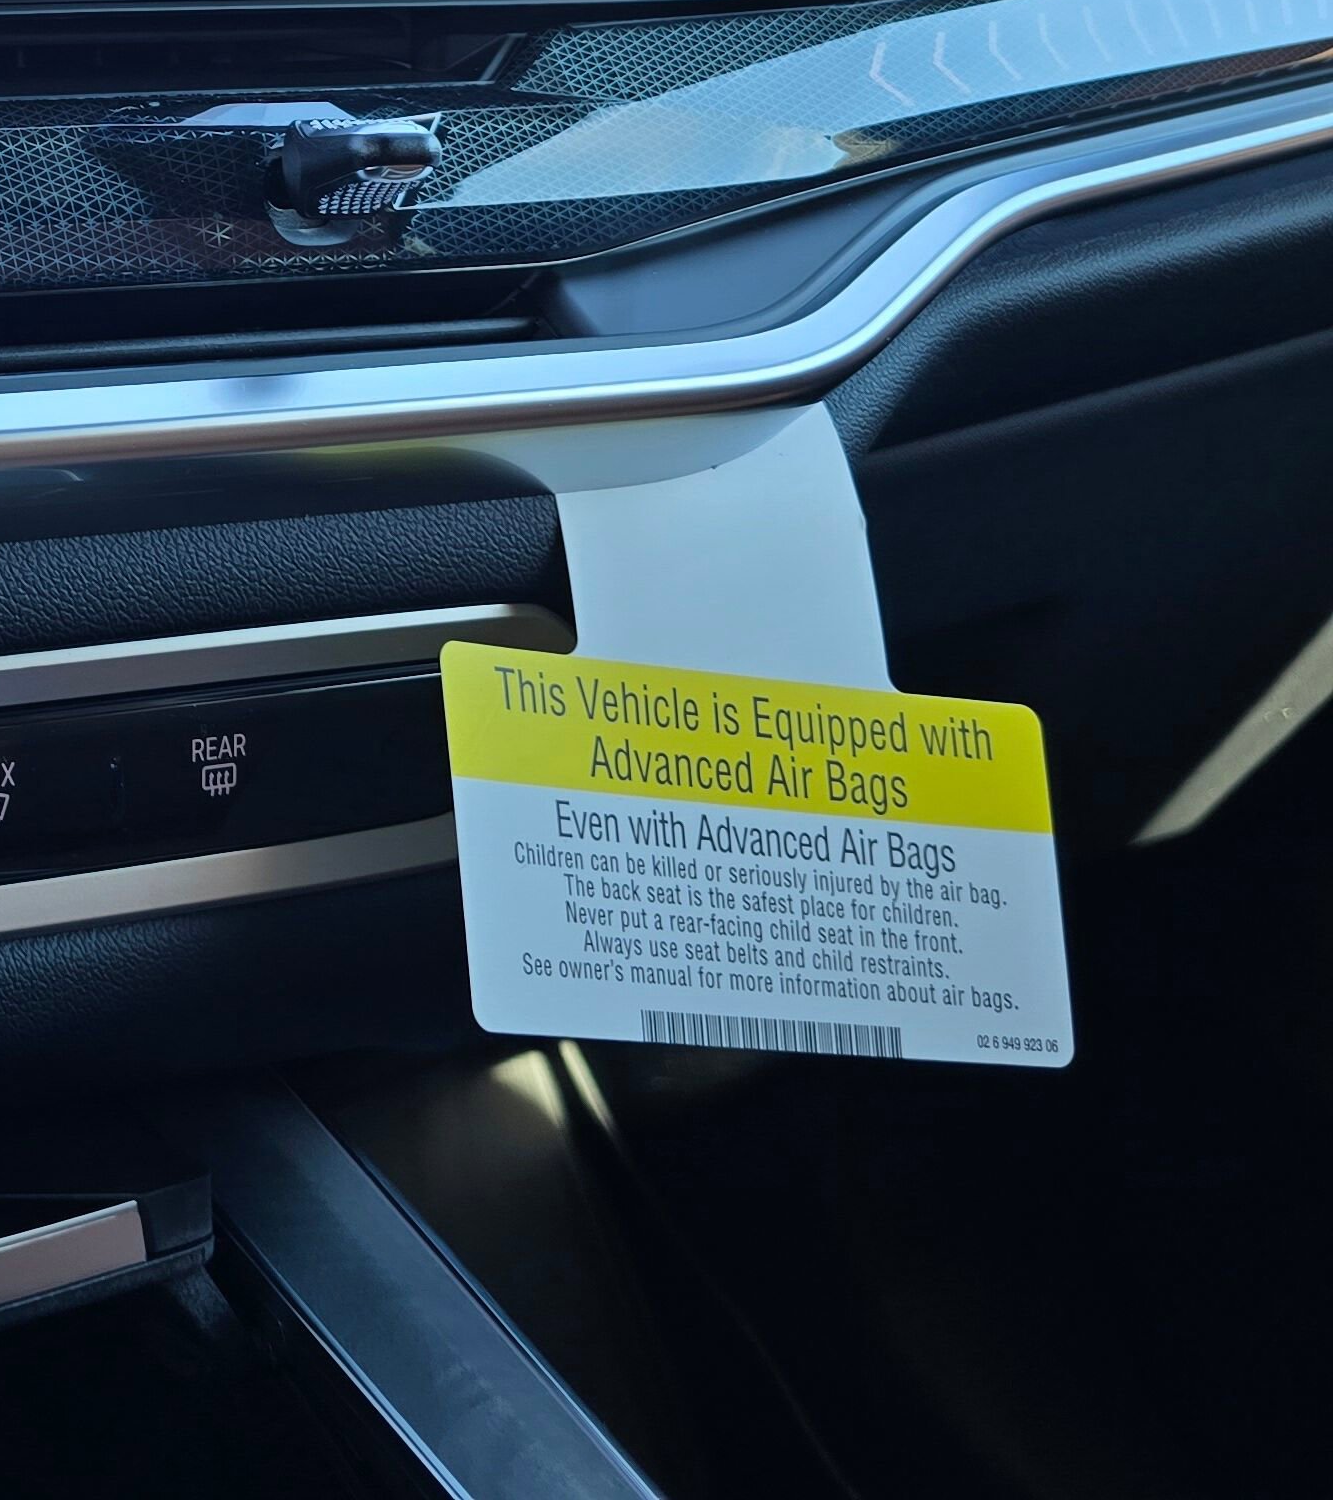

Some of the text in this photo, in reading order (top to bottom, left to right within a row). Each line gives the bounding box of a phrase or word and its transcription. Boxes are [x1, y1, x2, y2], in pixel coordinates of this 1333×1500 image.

[494, 666, 993, 761] This Vehicle is Equipped with
[191, 733, 247, 763] REAR
[590, 735, 908, 816] Advanced Air Bags
[555, 799, 956, 879] Even with Advanced Air Bags
[514, 841, 1008, 909] Children can be killed or seriously injured by the air bag.
[563, 873, 959, 928] The back seat is the safest place for children.
[565, 900, 964, 955] Never put a rear-facing child seat in the front.
[583, 929, 950, 980] Always use seat belts and child restraints.
[522, 952, 1020, 1013] See owner's manual for more information about air bags.
[976, 1034, 1059, 1053] 02 6 949 923 06
